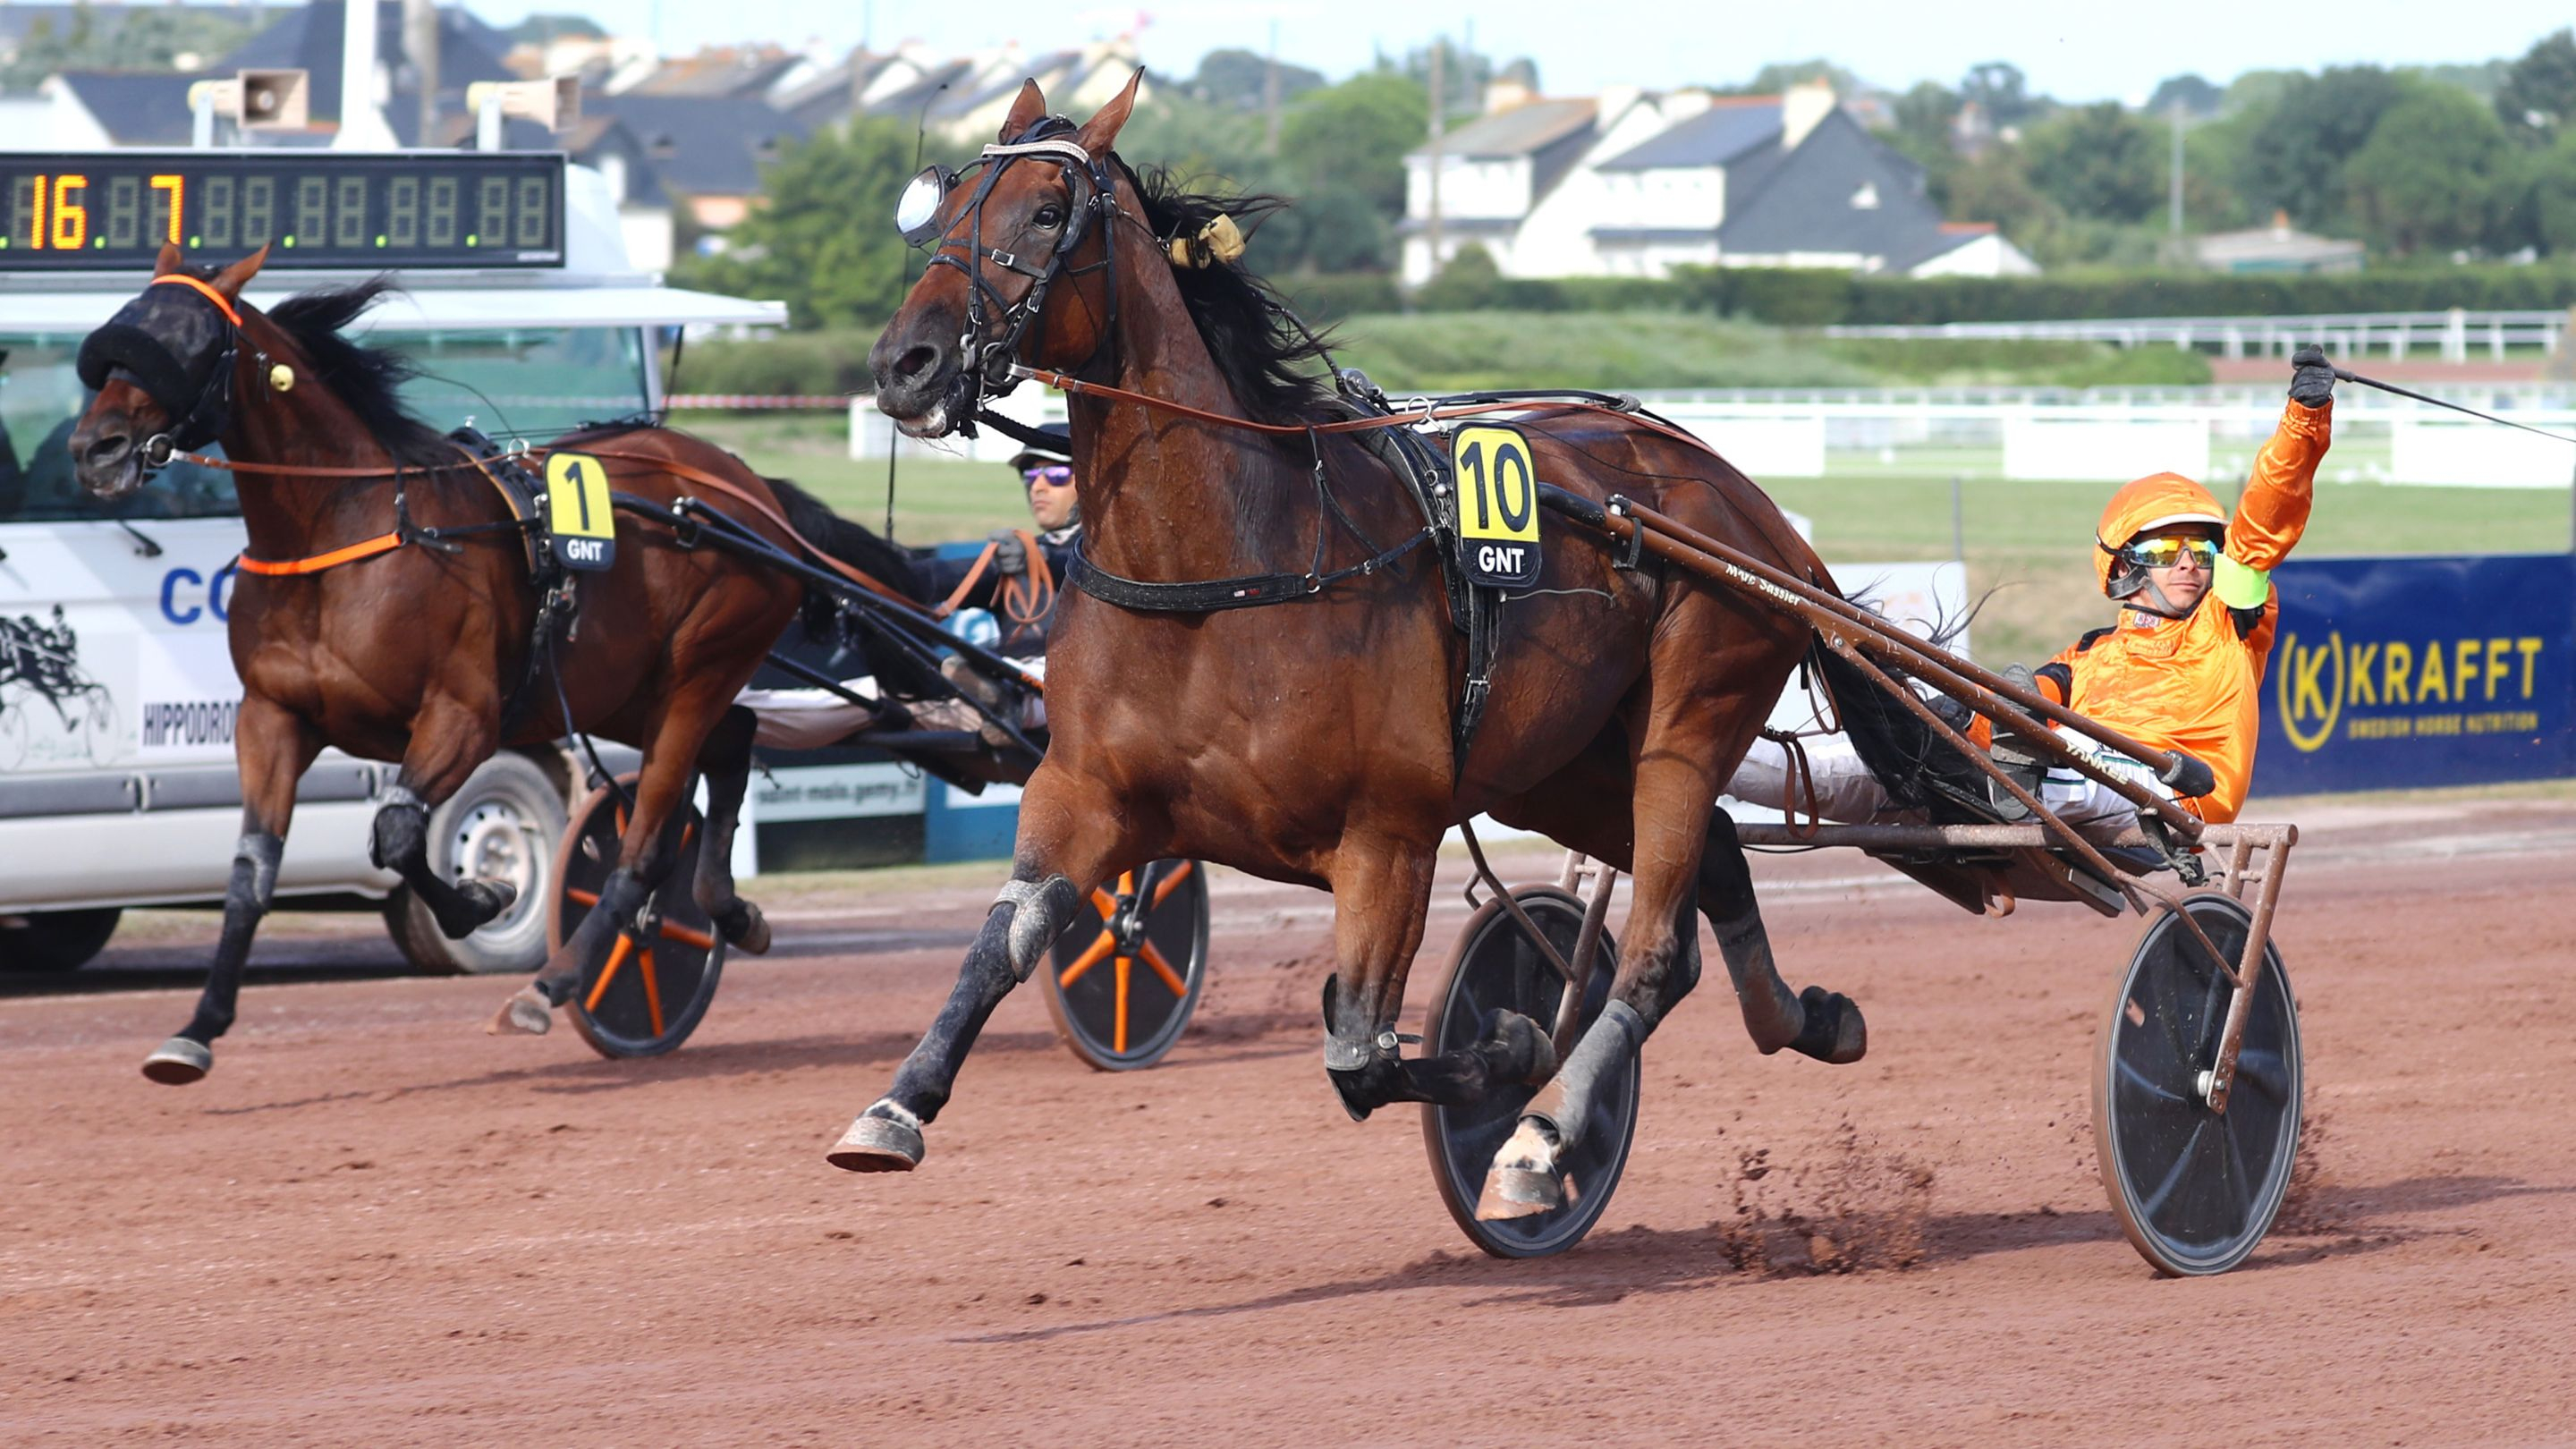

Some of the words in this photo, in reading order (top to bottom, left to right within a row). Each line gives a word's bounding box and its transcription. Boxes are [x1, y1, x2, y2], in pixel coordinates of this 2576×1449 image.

[31, 174, 89, 250] 16
[149, 174, 184, 245] 7
[564, 461, 590, 531] 1
[1460, 441, 1531, 532] 10
[566, 538, 603, 562] GNT
[1478, 545, 1525, 573] GNT
[1758, 578, 1801, 606] Sassier
[2348, 638, 2544, 706] KRAFFT
[2065, 741, 2129, 786] YANKEE
